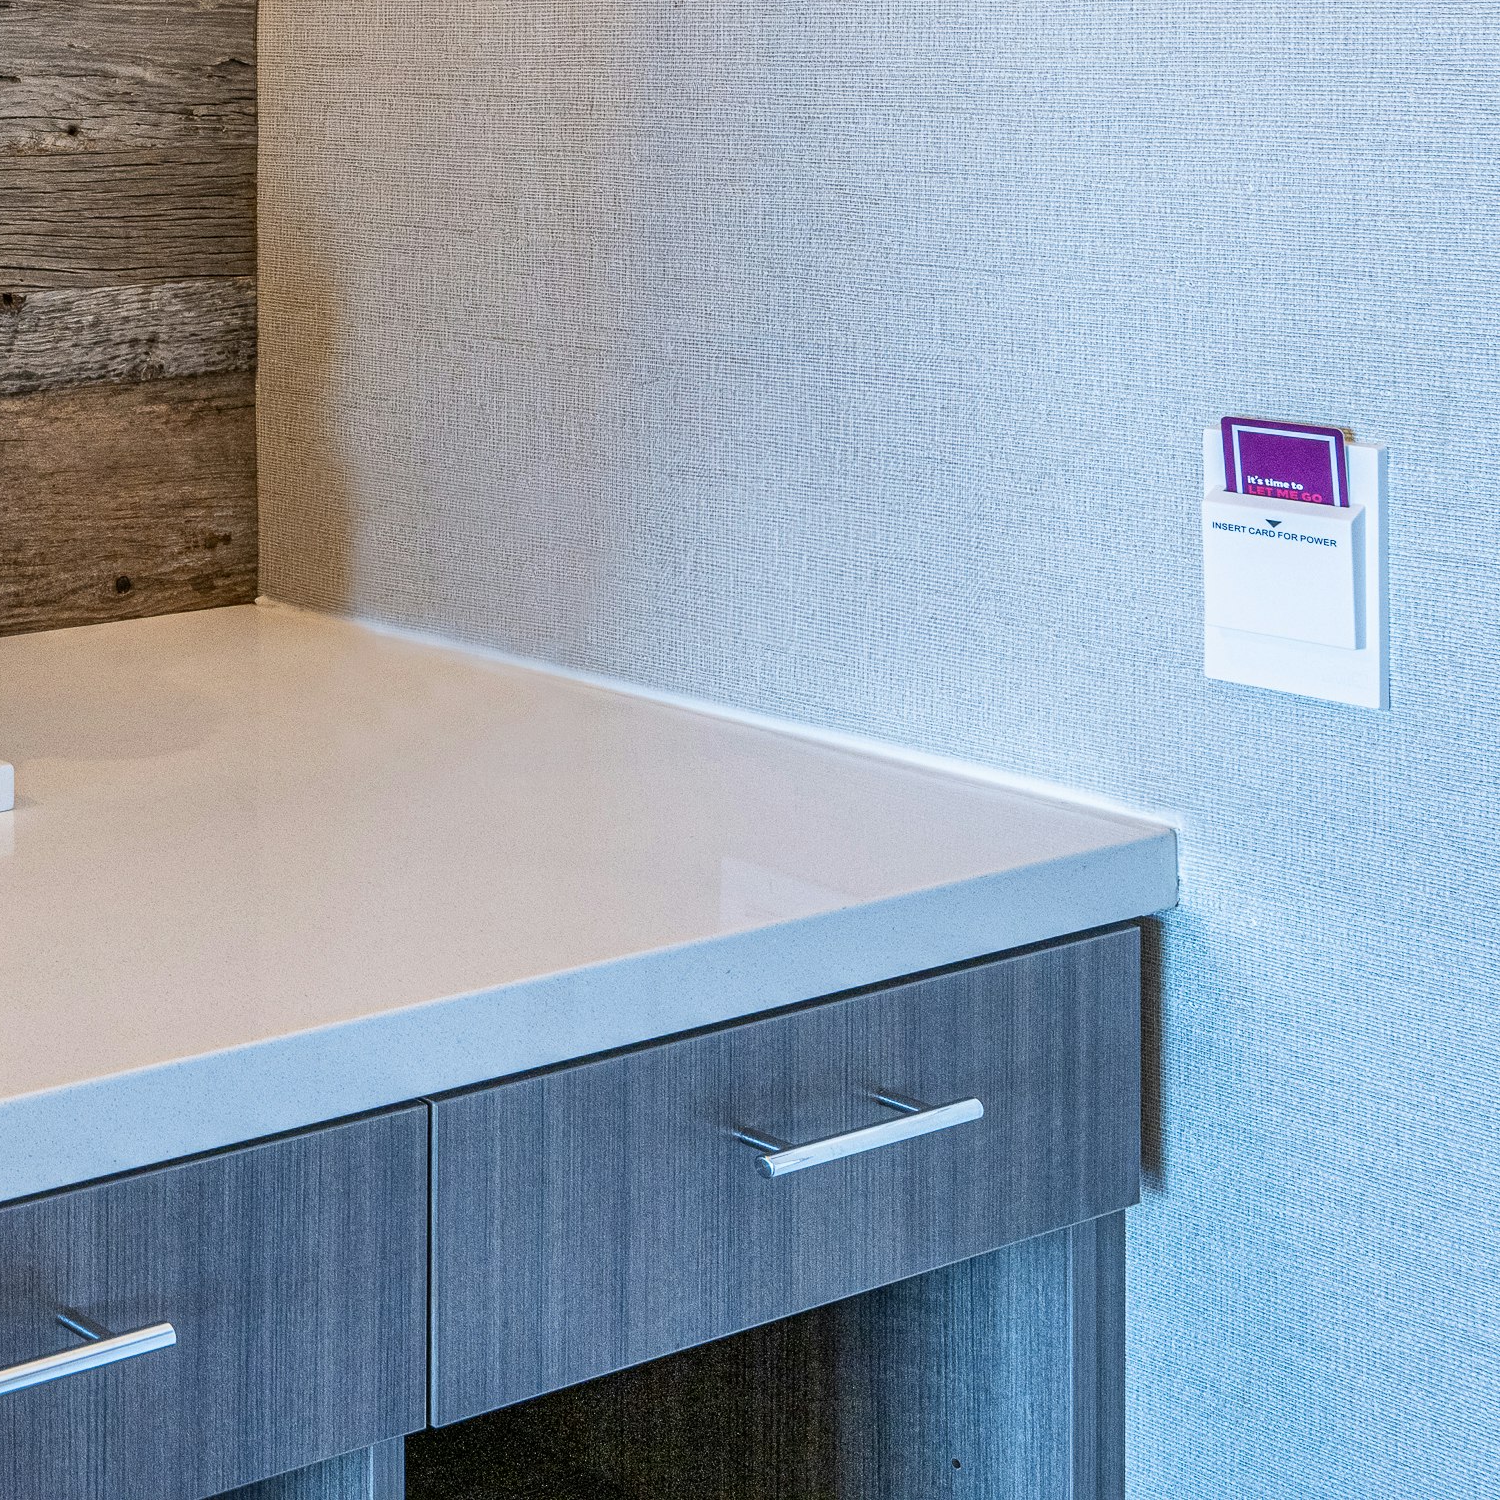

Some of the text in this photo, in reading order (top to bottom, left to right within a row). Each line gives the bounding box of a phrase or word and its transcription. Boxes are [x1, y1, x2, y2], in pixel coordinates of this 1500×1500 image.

[1264, 478, 1290, 489] time
[1291, 481, 1304, 490] to
[1248, 485, 1322, 503] LET ME GO
[1212, 521, 1337, 547] INSERT CARD FOR POWER
